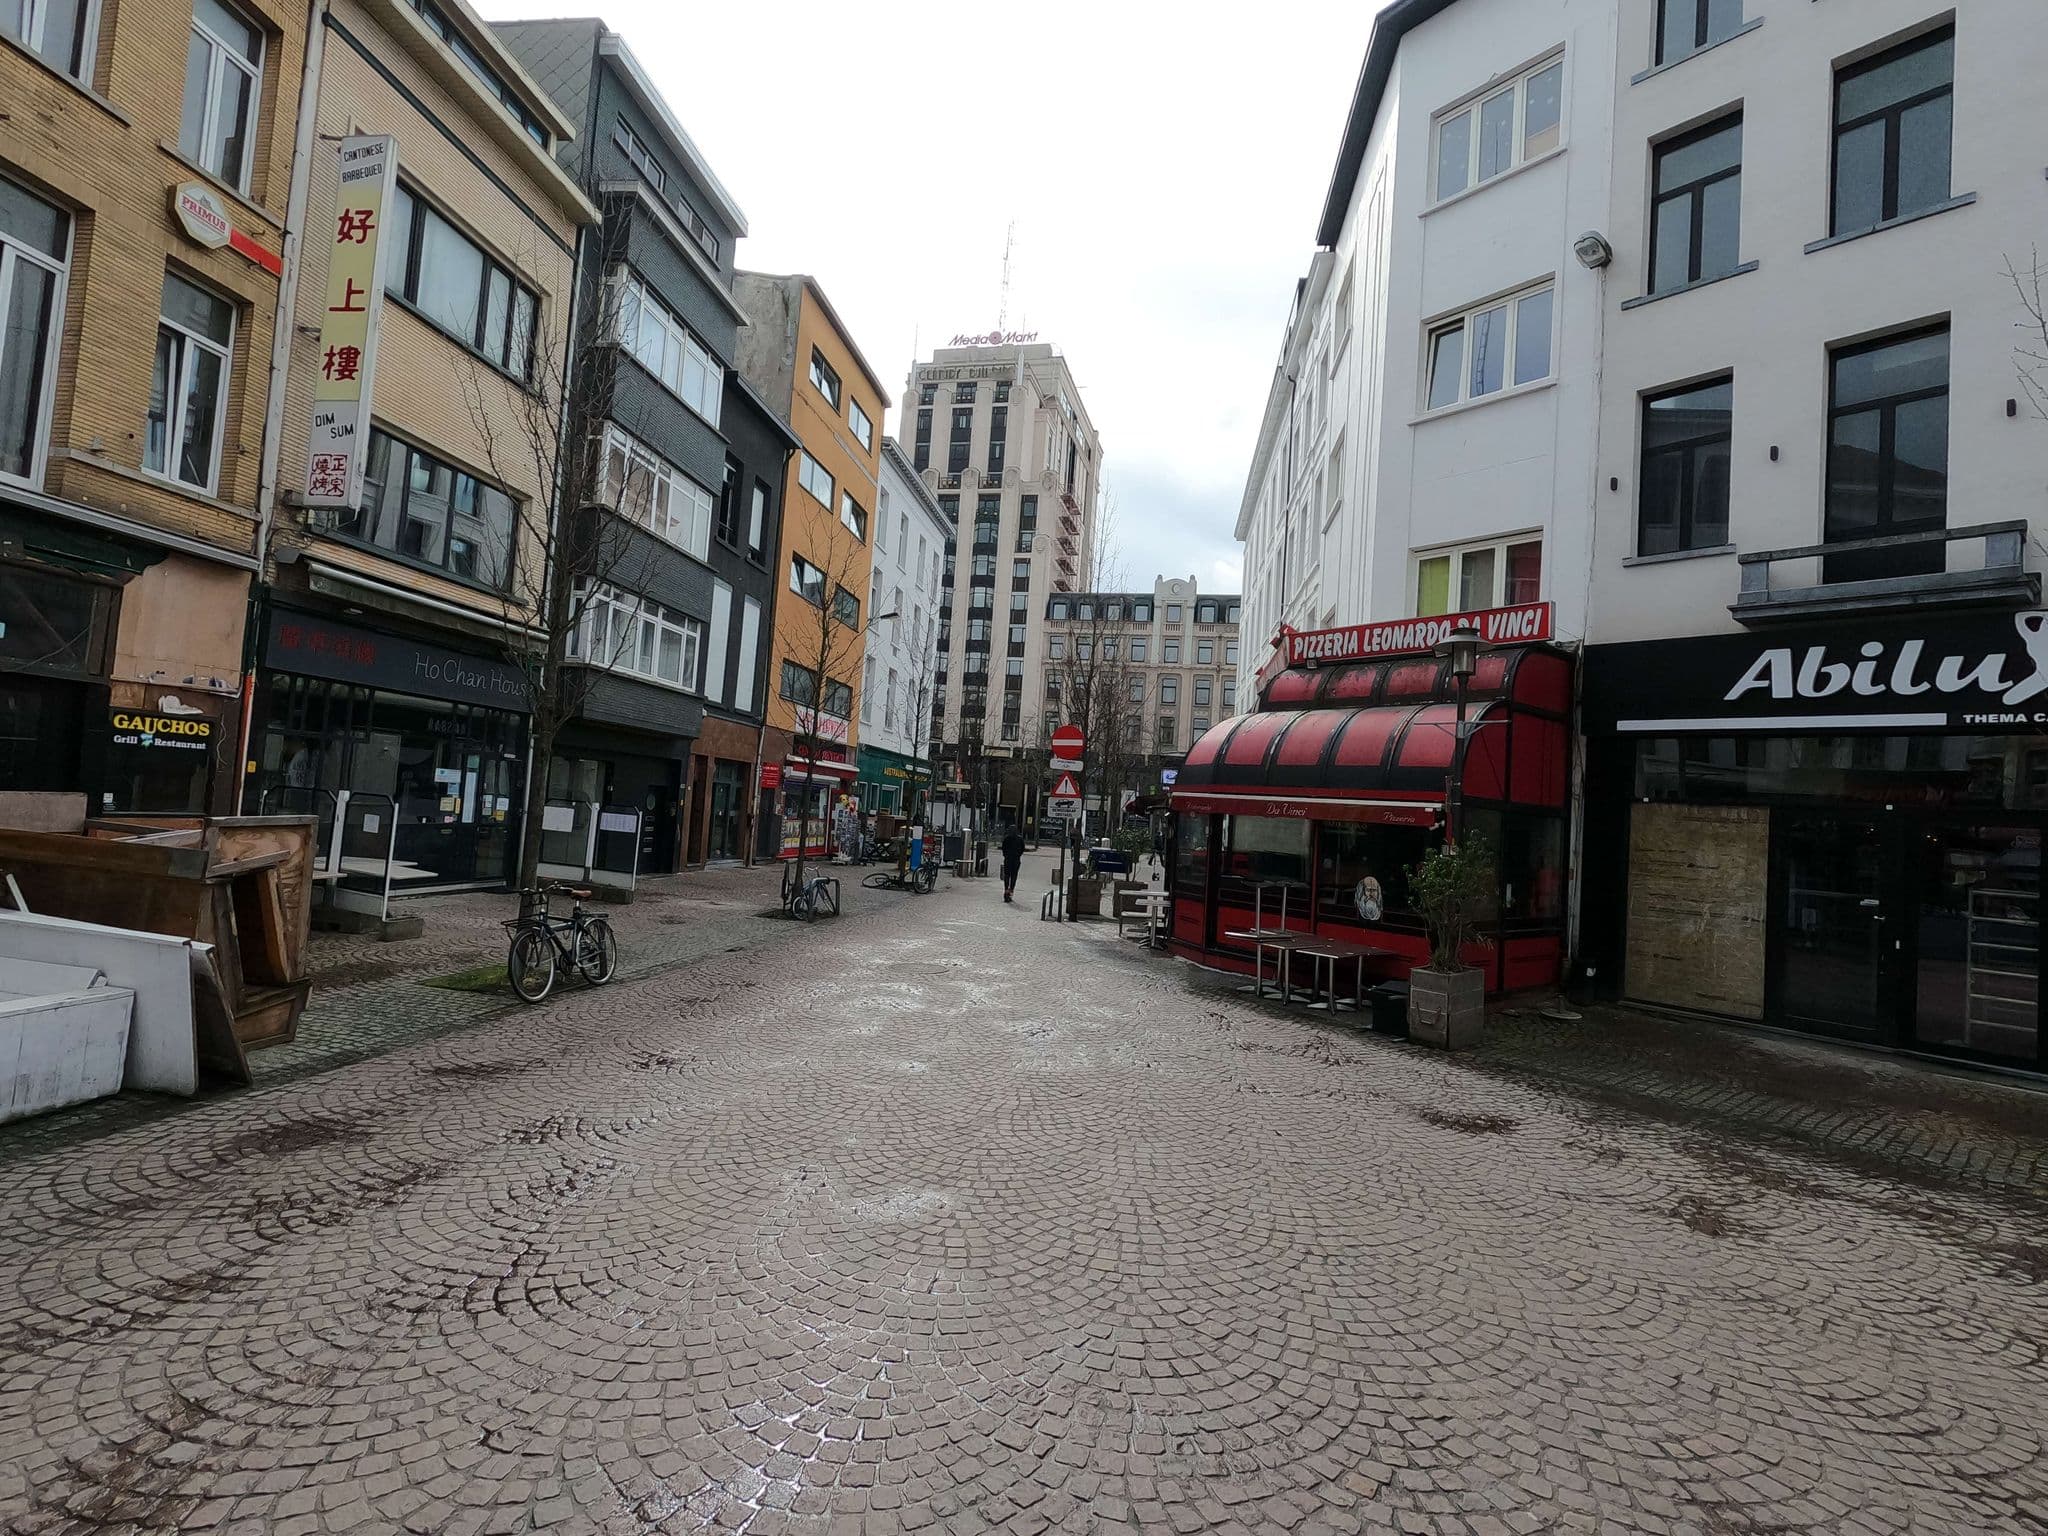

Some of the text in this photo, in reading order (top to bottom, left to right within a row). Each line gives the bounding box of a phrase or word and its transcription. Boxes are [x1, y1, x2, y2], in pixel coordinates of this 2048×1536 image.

[343, 142, 384, 162] CANTONESE
[342, 163, 383, 183] BARBEQUED
[181, 195, 227, 232] PRIMUS
[322, 207, 375, 381] 好上樓
[948, 331, 1039, 346] Media Markt
[315, 412, 335, 428] DIM
[330, 423, 354, 439] SUM
[1293, 630, 1358, 661] PIZZERIA
[1363, 618, 1452, 653] LEONARDO
[1487, 607, 1542, 641] VINCI
[415, 652, 440, 680] Ho
[443, 659, 487, 690] Chan
[113, 714, 210, 737] GAUCHOS
[1962, 713, 2028, 724] THEMA
[113, 735, 206, 750] Grill Restaurant
